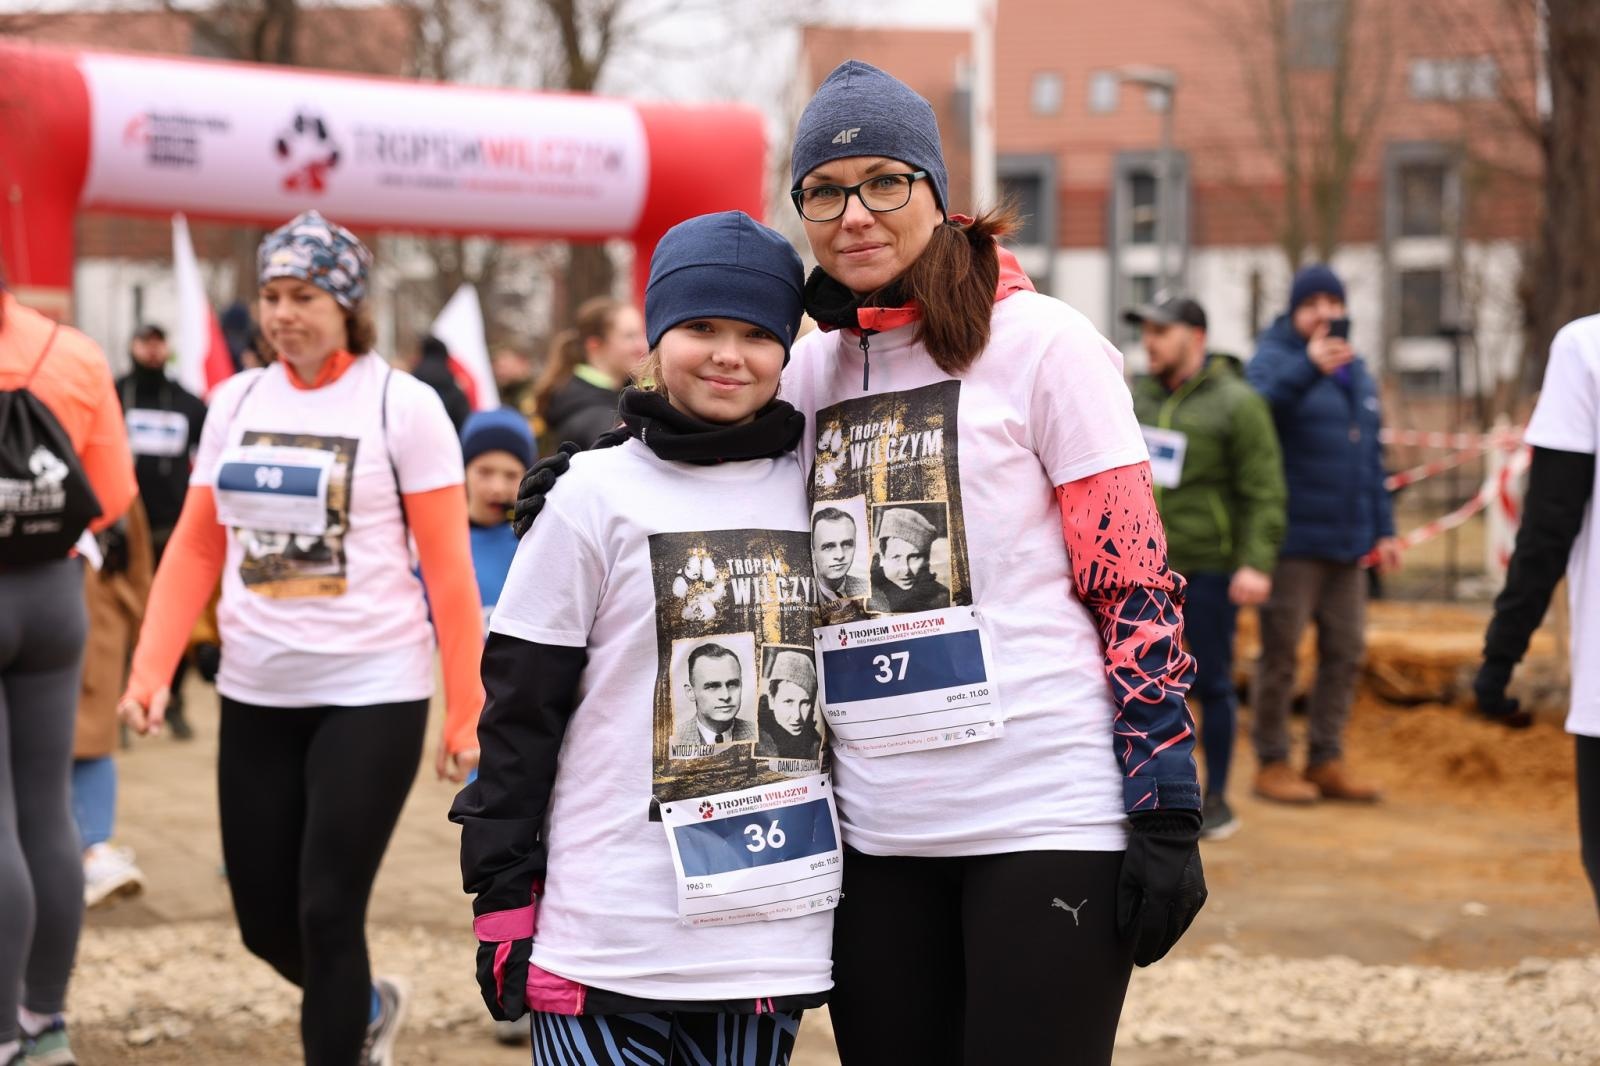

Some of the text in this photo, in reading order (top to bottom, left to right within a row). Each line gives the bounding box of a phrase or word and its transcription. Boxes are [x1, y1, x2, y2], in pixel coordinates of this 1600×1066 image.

[832, 128, 861, 144] 4F
[850, 419, 898, 441] TROPEM
[850, 429, 944, 469] WILCZYM
[727, 558, 781, 575] TROPEM
[849, 617, 945, 640] TROPEM WILCZYM
[873, 651, 910, 684] 37
[946, 689, 989, 703] godz. 11.00
[827, 710, 840, 718] 1963
[672, 744, 693, 757] WITOLD
[778, 760, 800, 773] DANUTA
[716, 786, 808, 811] TROPEM WILCZYM
[743, 819, 786, 853] 36
[810, 856, 840, 870] godz. 11.00
[686, 882, 704, 891] 1963
